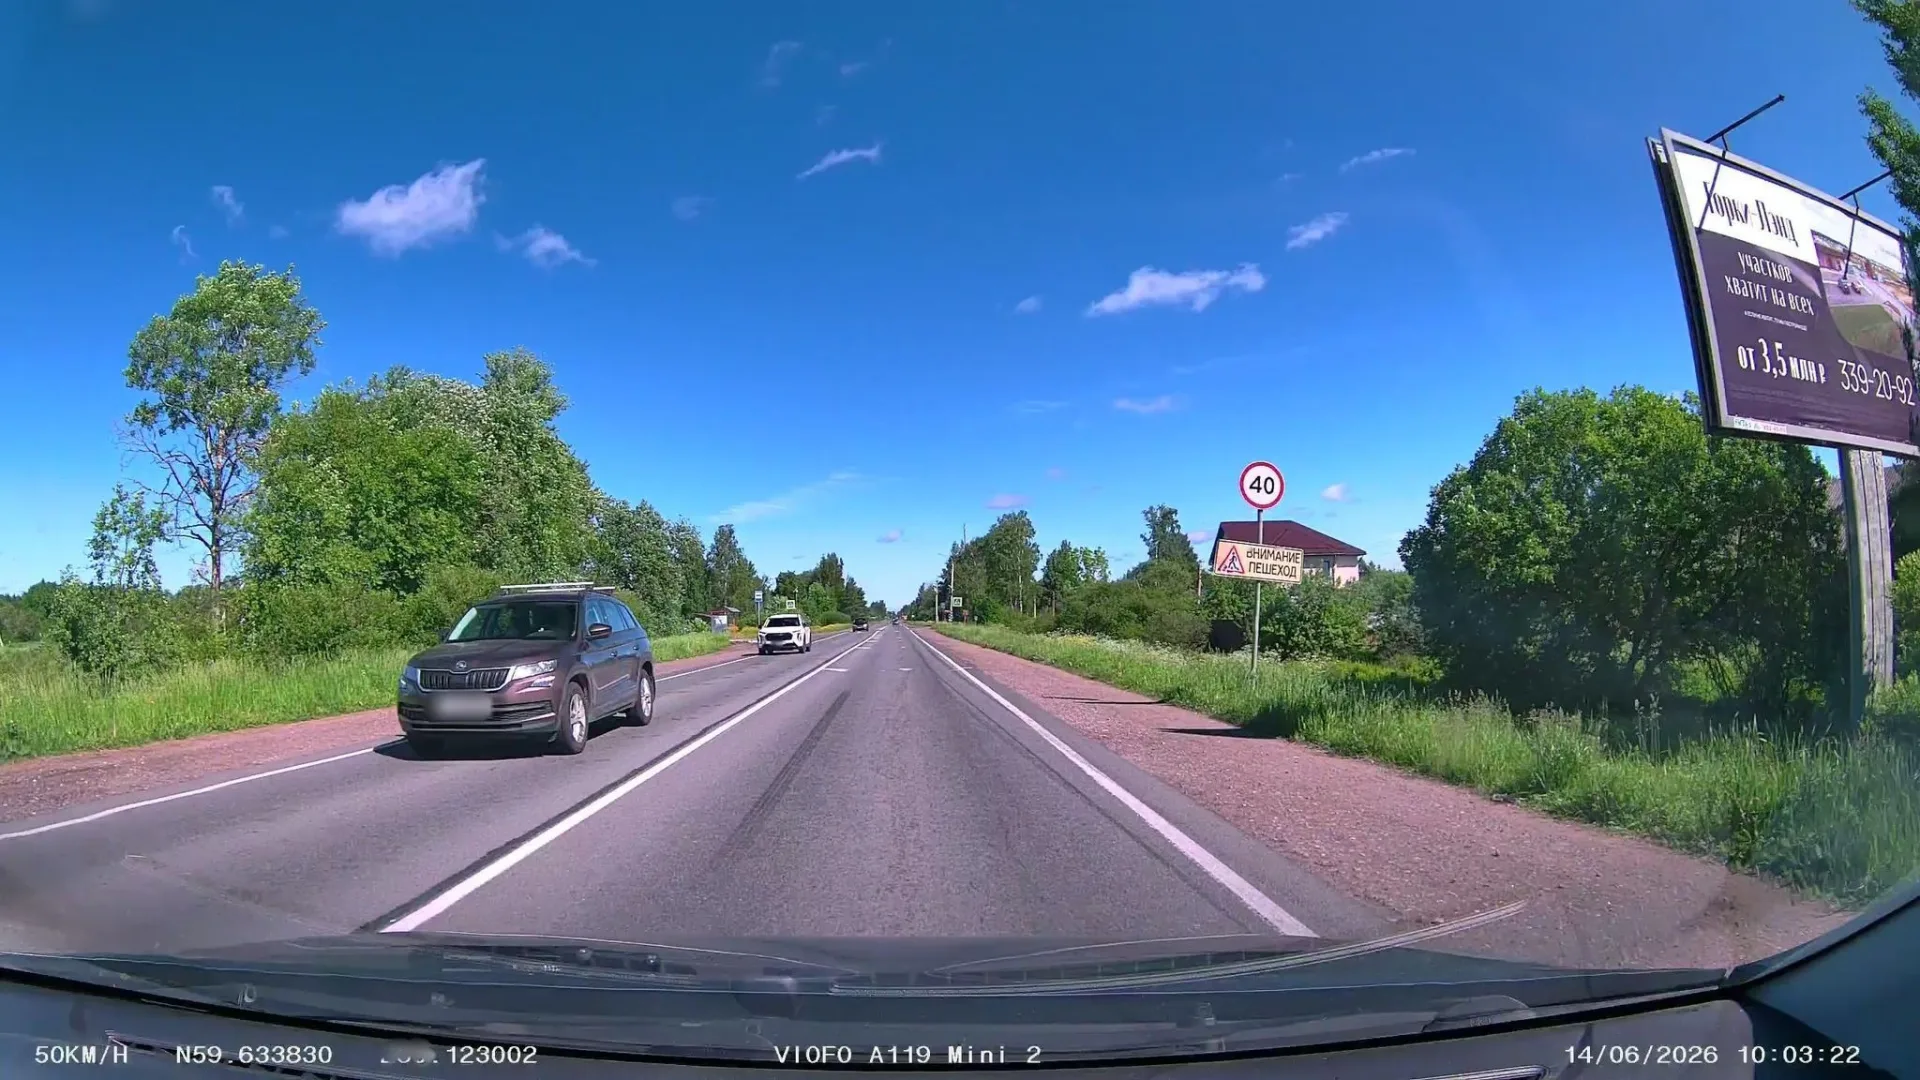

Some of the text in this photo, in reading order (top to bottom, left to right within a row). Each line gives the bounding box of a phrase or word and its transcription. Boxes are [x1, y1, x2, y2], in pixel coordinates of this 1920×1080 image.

[1737, 251, 1793, 284] участков
[1724, 275, 1815, 316] хватит на всех
[1737, 345, 1756, 371] от
[1757, 338, 1788, 378] 3,5
[1788, 356, 1818, 383] млн
[1837, 358, 1917, 407] 339-20-92
[1248, 475, 1275, 495] 40
[1246, 547, 1301, 564] ВНИМАНИЕ
[1248, 561, 1297, 579] ПЕШЕХОД
